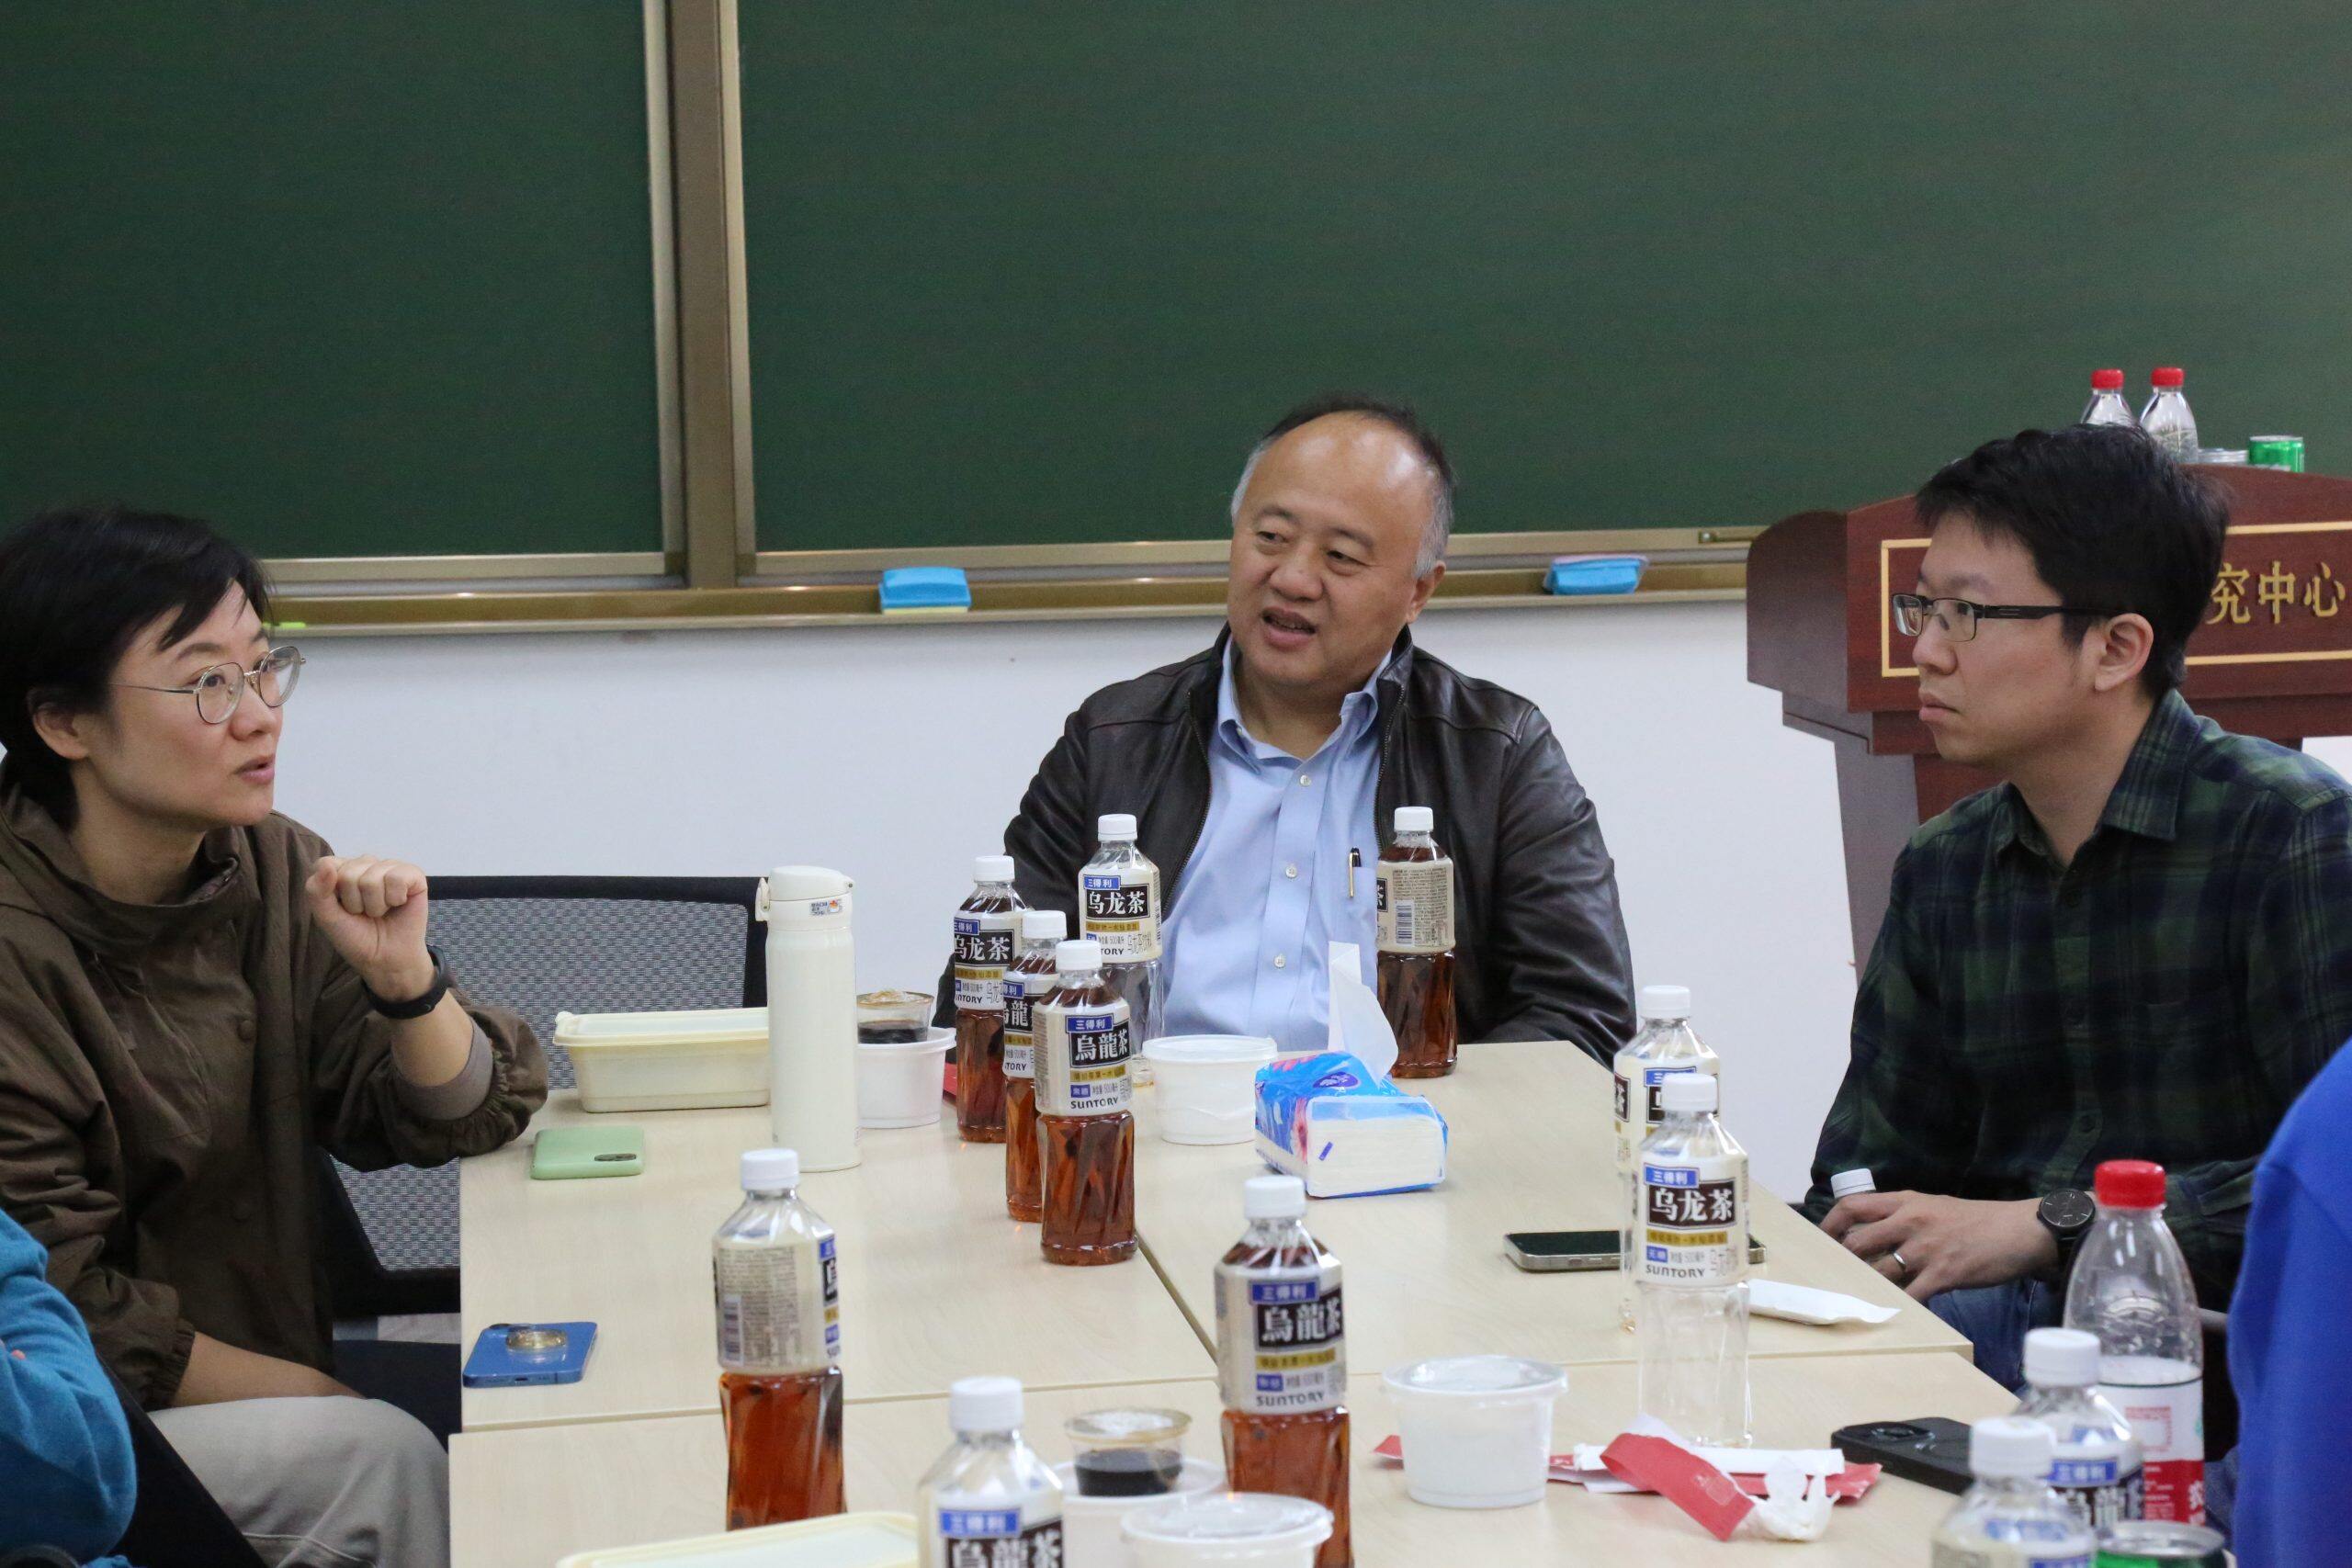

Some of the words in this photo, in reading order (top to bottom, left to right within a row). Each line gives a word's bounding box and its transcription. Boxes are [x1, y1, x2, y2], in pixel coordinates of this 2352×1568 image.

[2206, 560, 2346, 626] 究中心
[1088, 877, 1113, 888] 三得利
[1088, 890, 1146, 915] 乌龙茶
[955, 935, 1011, 962] 乌龙茶
[1101, 948, 1125, 956] TORY
[1076, 1019, 1106, 1030] 三得利
[1075, 1028, 1128, 1061] 烏龍茶
[1651, 1188, 1733, 1222] 乌龙茶
